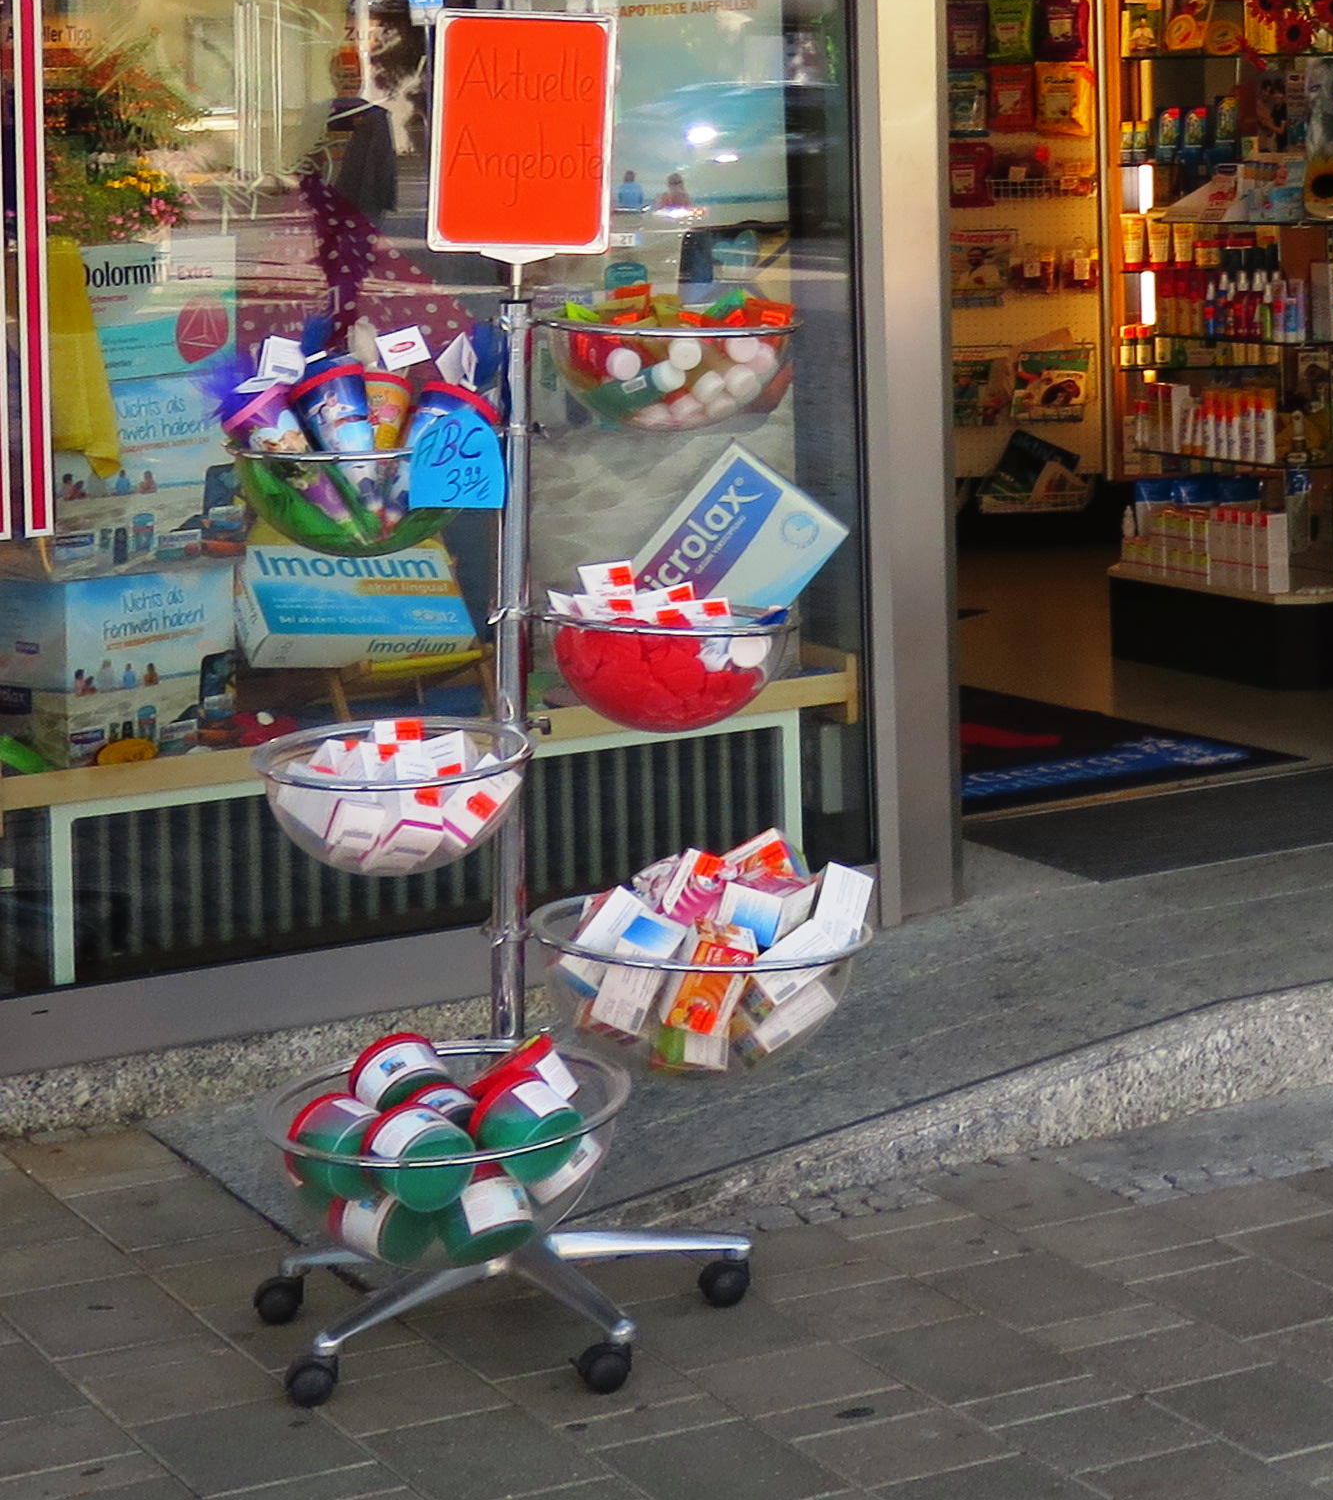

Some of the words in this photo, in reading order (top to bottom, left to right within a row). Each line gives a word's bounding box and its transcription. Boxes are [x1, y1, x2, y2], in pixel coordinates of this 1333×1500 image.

[456, 47, 595, 102] Aktuelle
[447, 122, 603, 209] Angebote
[416, 419, 484, 468] ABC
[401, 582, 448, 596] lingual
[366, 638, 457, 655] Imodium
